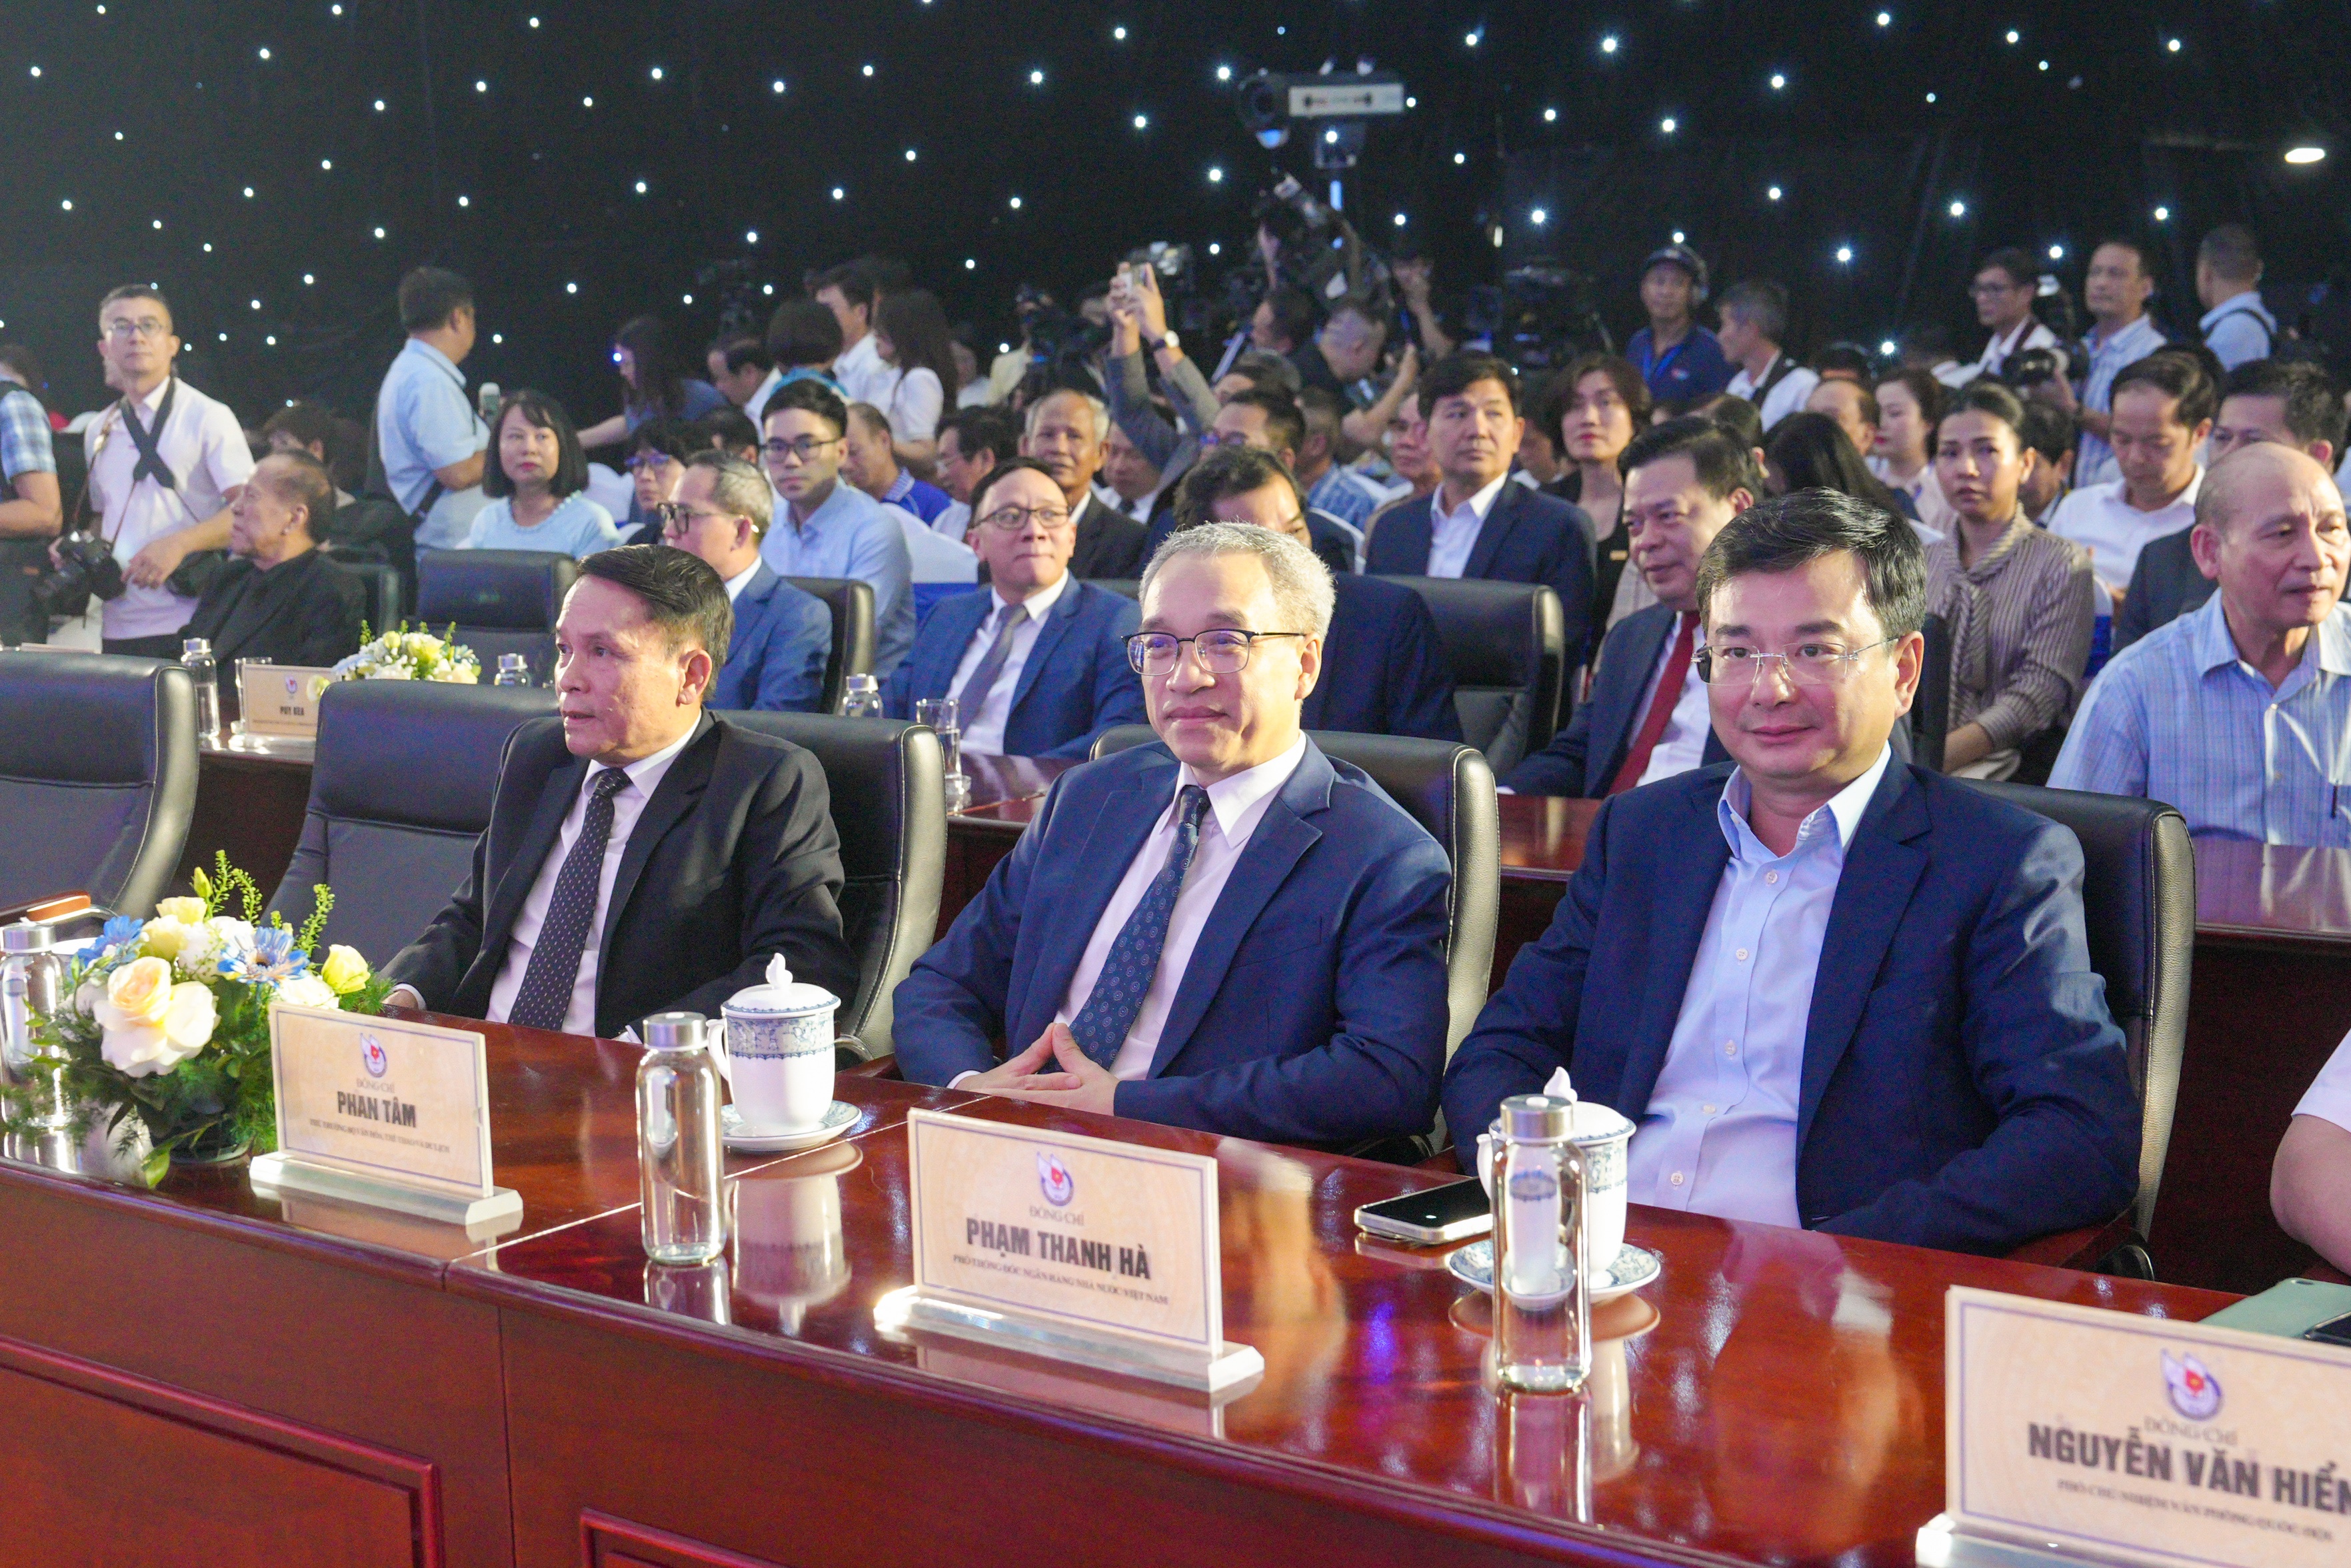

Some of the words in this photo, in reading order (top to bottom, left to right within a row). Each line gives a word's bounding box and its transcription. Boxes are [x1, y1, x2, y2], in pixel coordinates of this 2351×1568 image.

[337, 1091, 379, 1120] PHAN
[383, 1096, 416, 1128] TÂM
[967, 1217, 1030, 1257] PHẠM
[1037, 1231, 1112, 1272] THANH
[1119, 1243, 1151, 1279] HÀ
[2028, 1422, 2171, 1482] NGUYỄN
[2184, 1449, 2260, 1497] VĂN
